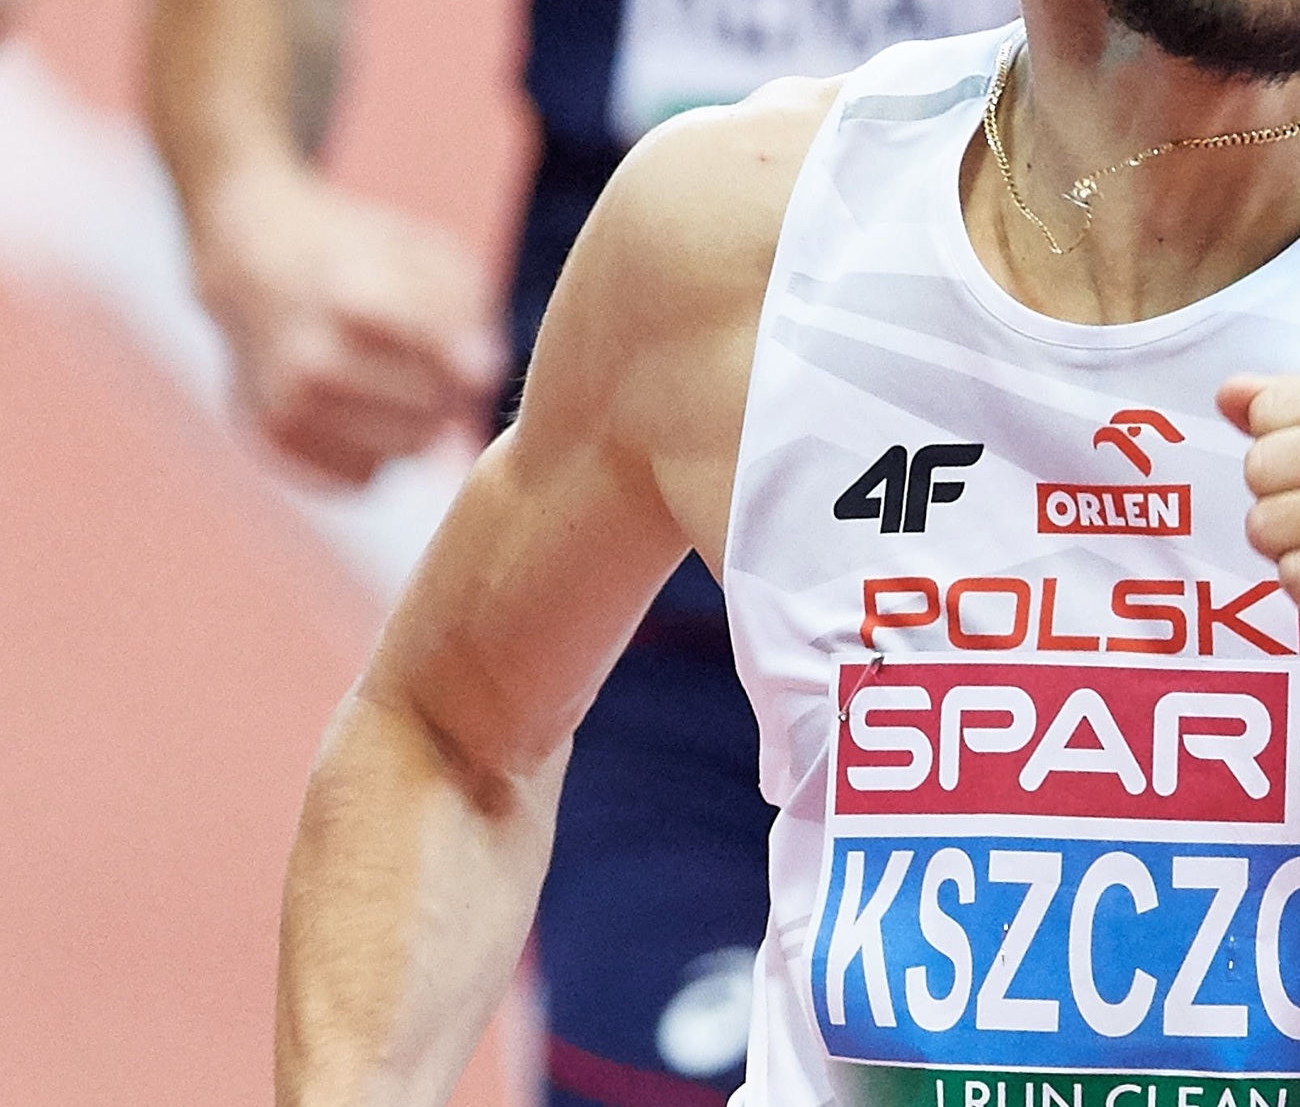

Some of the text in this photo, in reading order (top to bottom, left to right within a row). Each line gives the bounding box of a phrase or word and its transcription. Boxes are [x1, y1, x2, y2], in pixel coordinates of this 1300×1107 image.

[833, 443, 984, 533] 4F
[1045, 491, 1182, 529] ORLEN
[846, 685, 1272, 799] SPAR
